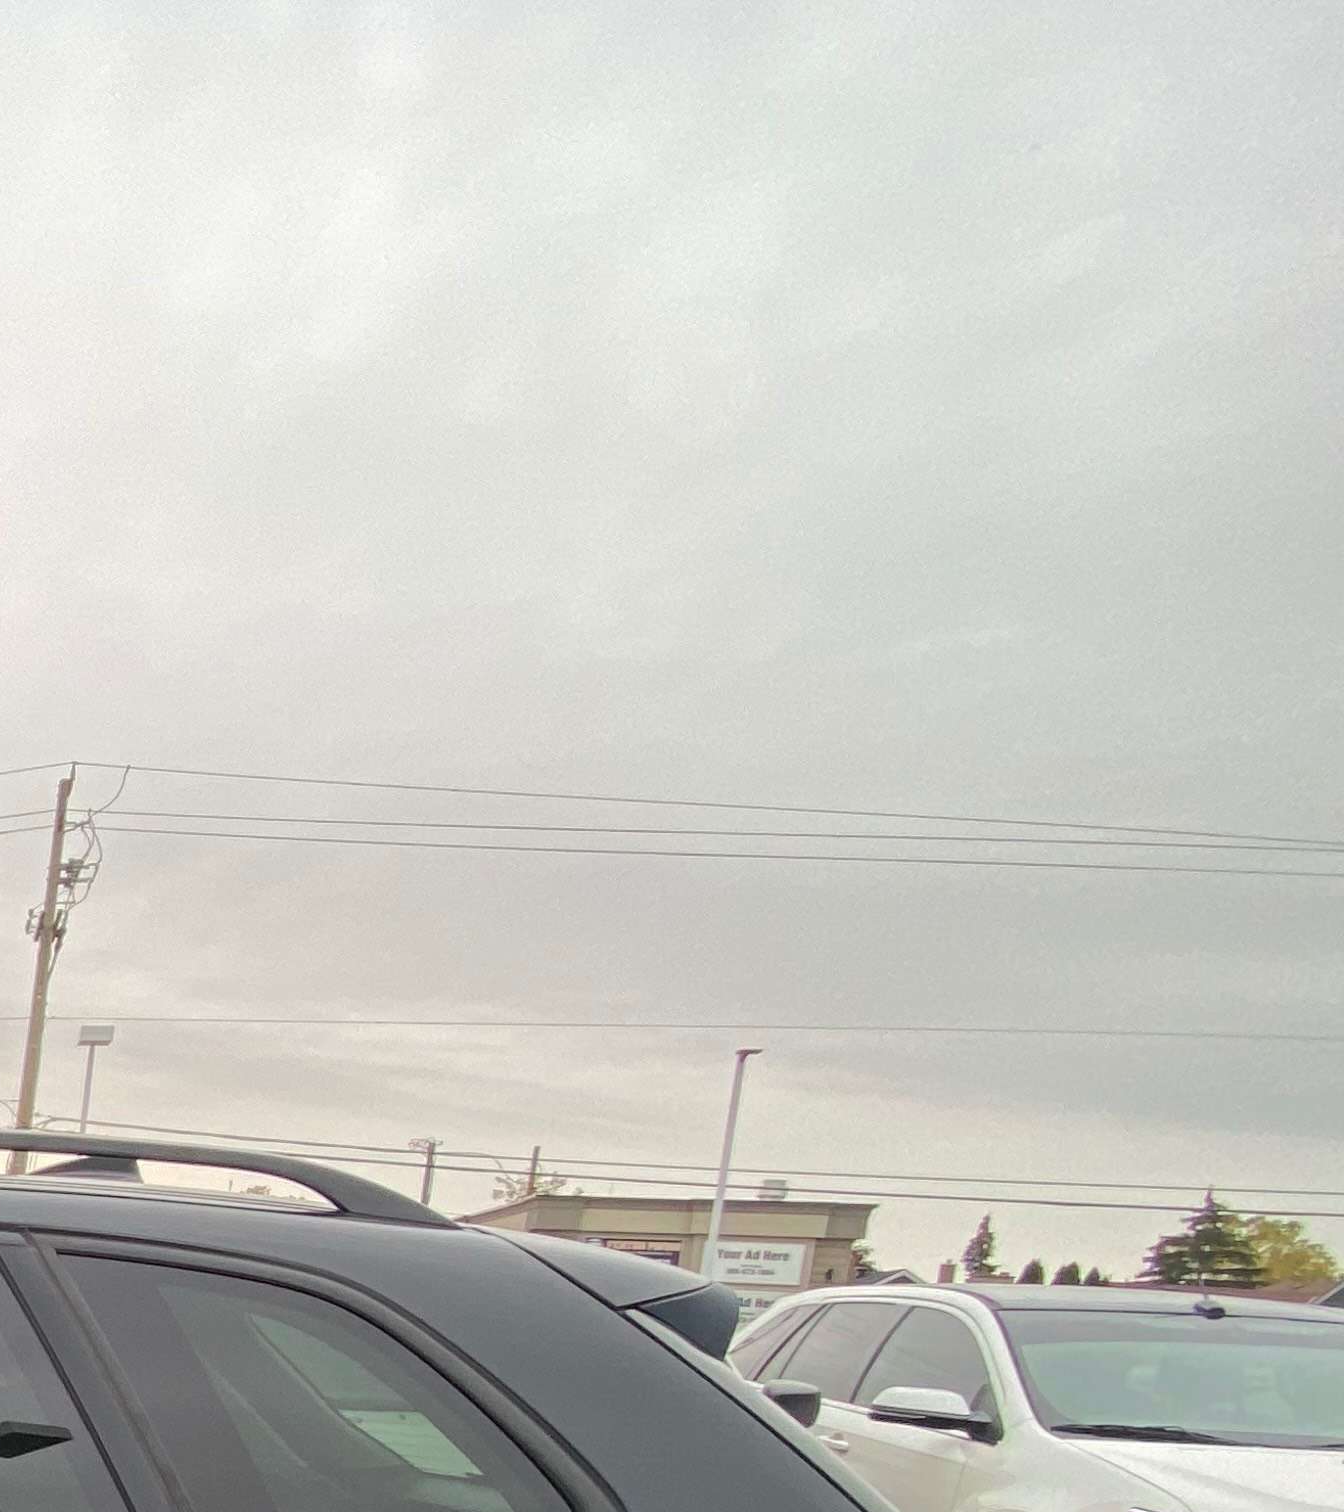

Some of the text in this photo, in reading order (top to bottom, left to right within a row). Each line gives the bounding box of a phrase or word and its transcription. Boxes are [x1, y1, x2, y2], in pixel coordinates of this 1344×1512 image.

[717, 1249, 790, 1261] Your Ad Here
